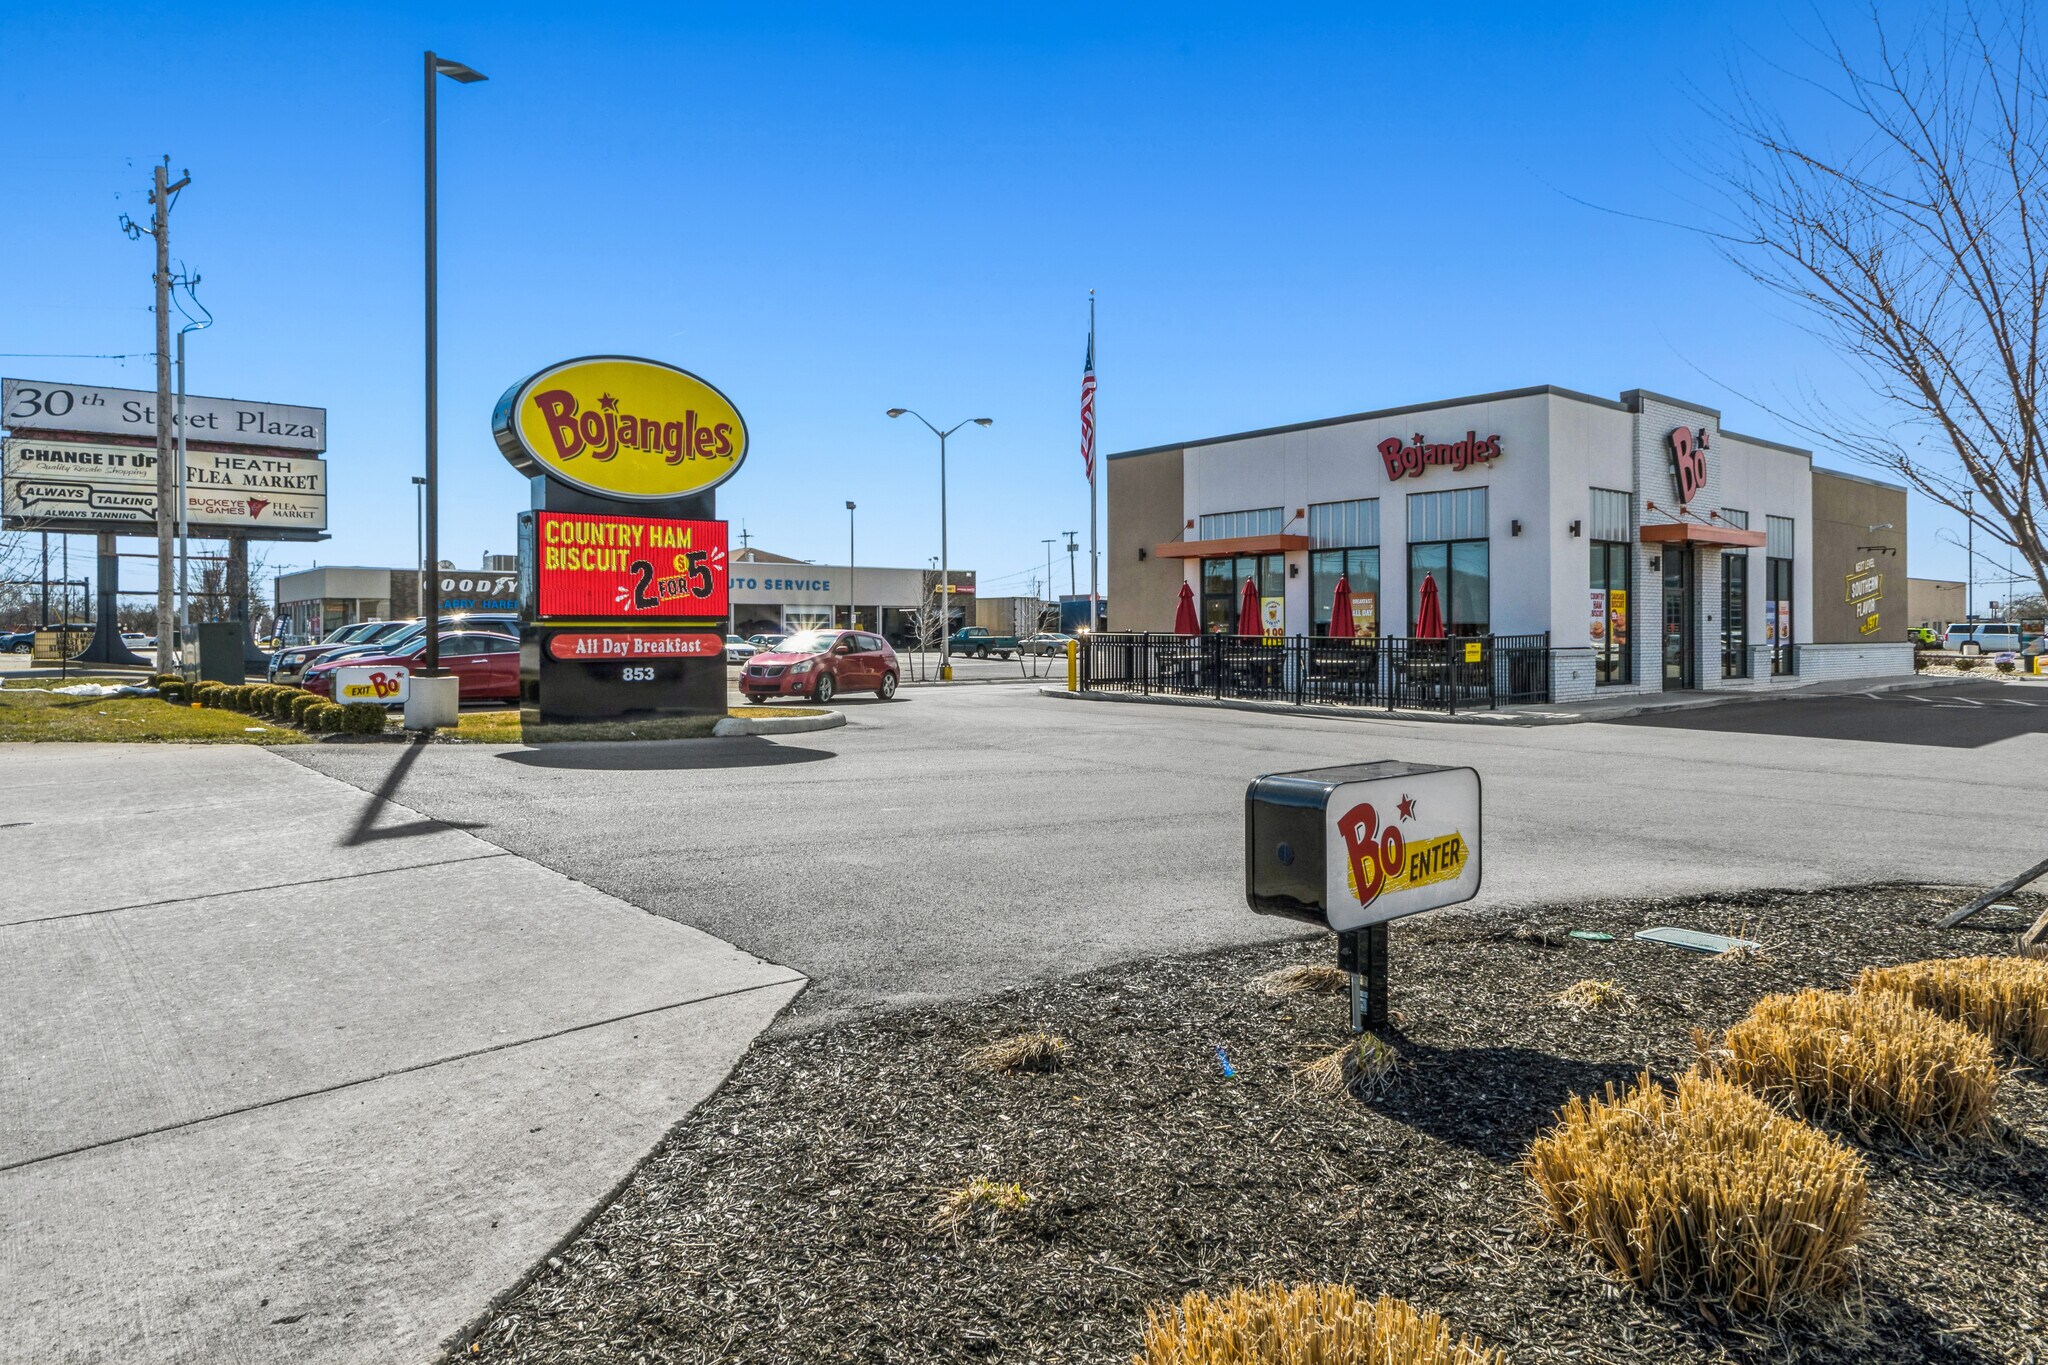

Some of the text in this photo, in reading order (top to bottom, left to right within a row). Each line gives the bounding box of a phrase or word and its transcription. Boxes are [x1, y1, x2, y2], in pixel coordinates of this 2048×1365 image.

[122, 401, 219, 430] Steet
[236, 411, 317, 439] Plaza
[534, 389, 732, 464] Bojangles
[20, 448, 158, 468] CHANGE IT UP
[215, 457, 292, 473] HEATH
[1377, 431, 1500, 481] Bojangles
[1668, 426, 1706, 504] Bo
[36, 462, 148, 478] Quality Resale Shopping
[186, 466, 318, 490] FLEA MARKET
[25, 488, 85, 498] ALWAYS
[97, 496, 154, 506] TALKING
[189, 498, 245, 508] BUCKEYE
[205, 507, 246, 515] GAMES
[273, 503, 298, 511] FLEA
[44, 509, 137, 520] ALWAYS TANNING
[273, 510, 316, 519] MARKET
[545, 520, 692, 549] COUNTRY HAM
[545, 547, 631, 572] BISCUIT
[424, 578, 518, 593] OODY
[630, 560, 660, 610] 2
[658, 577, 689, 597] FOR
[765, 579, 830, 592] SERVICE
[1851, 575, 1879, 599] SOUTHERN
[1362, 609, 1373, 617] DAY
[1857, 598, 1876, 618] FLAVOR
[575, 638, 701, 656] All Day Breakfast
[623, 667, 655, 681] 853
[351, 671, 400, 699] EXIT Bo
[1337, 803, 1460, 909] Bo ENTER
